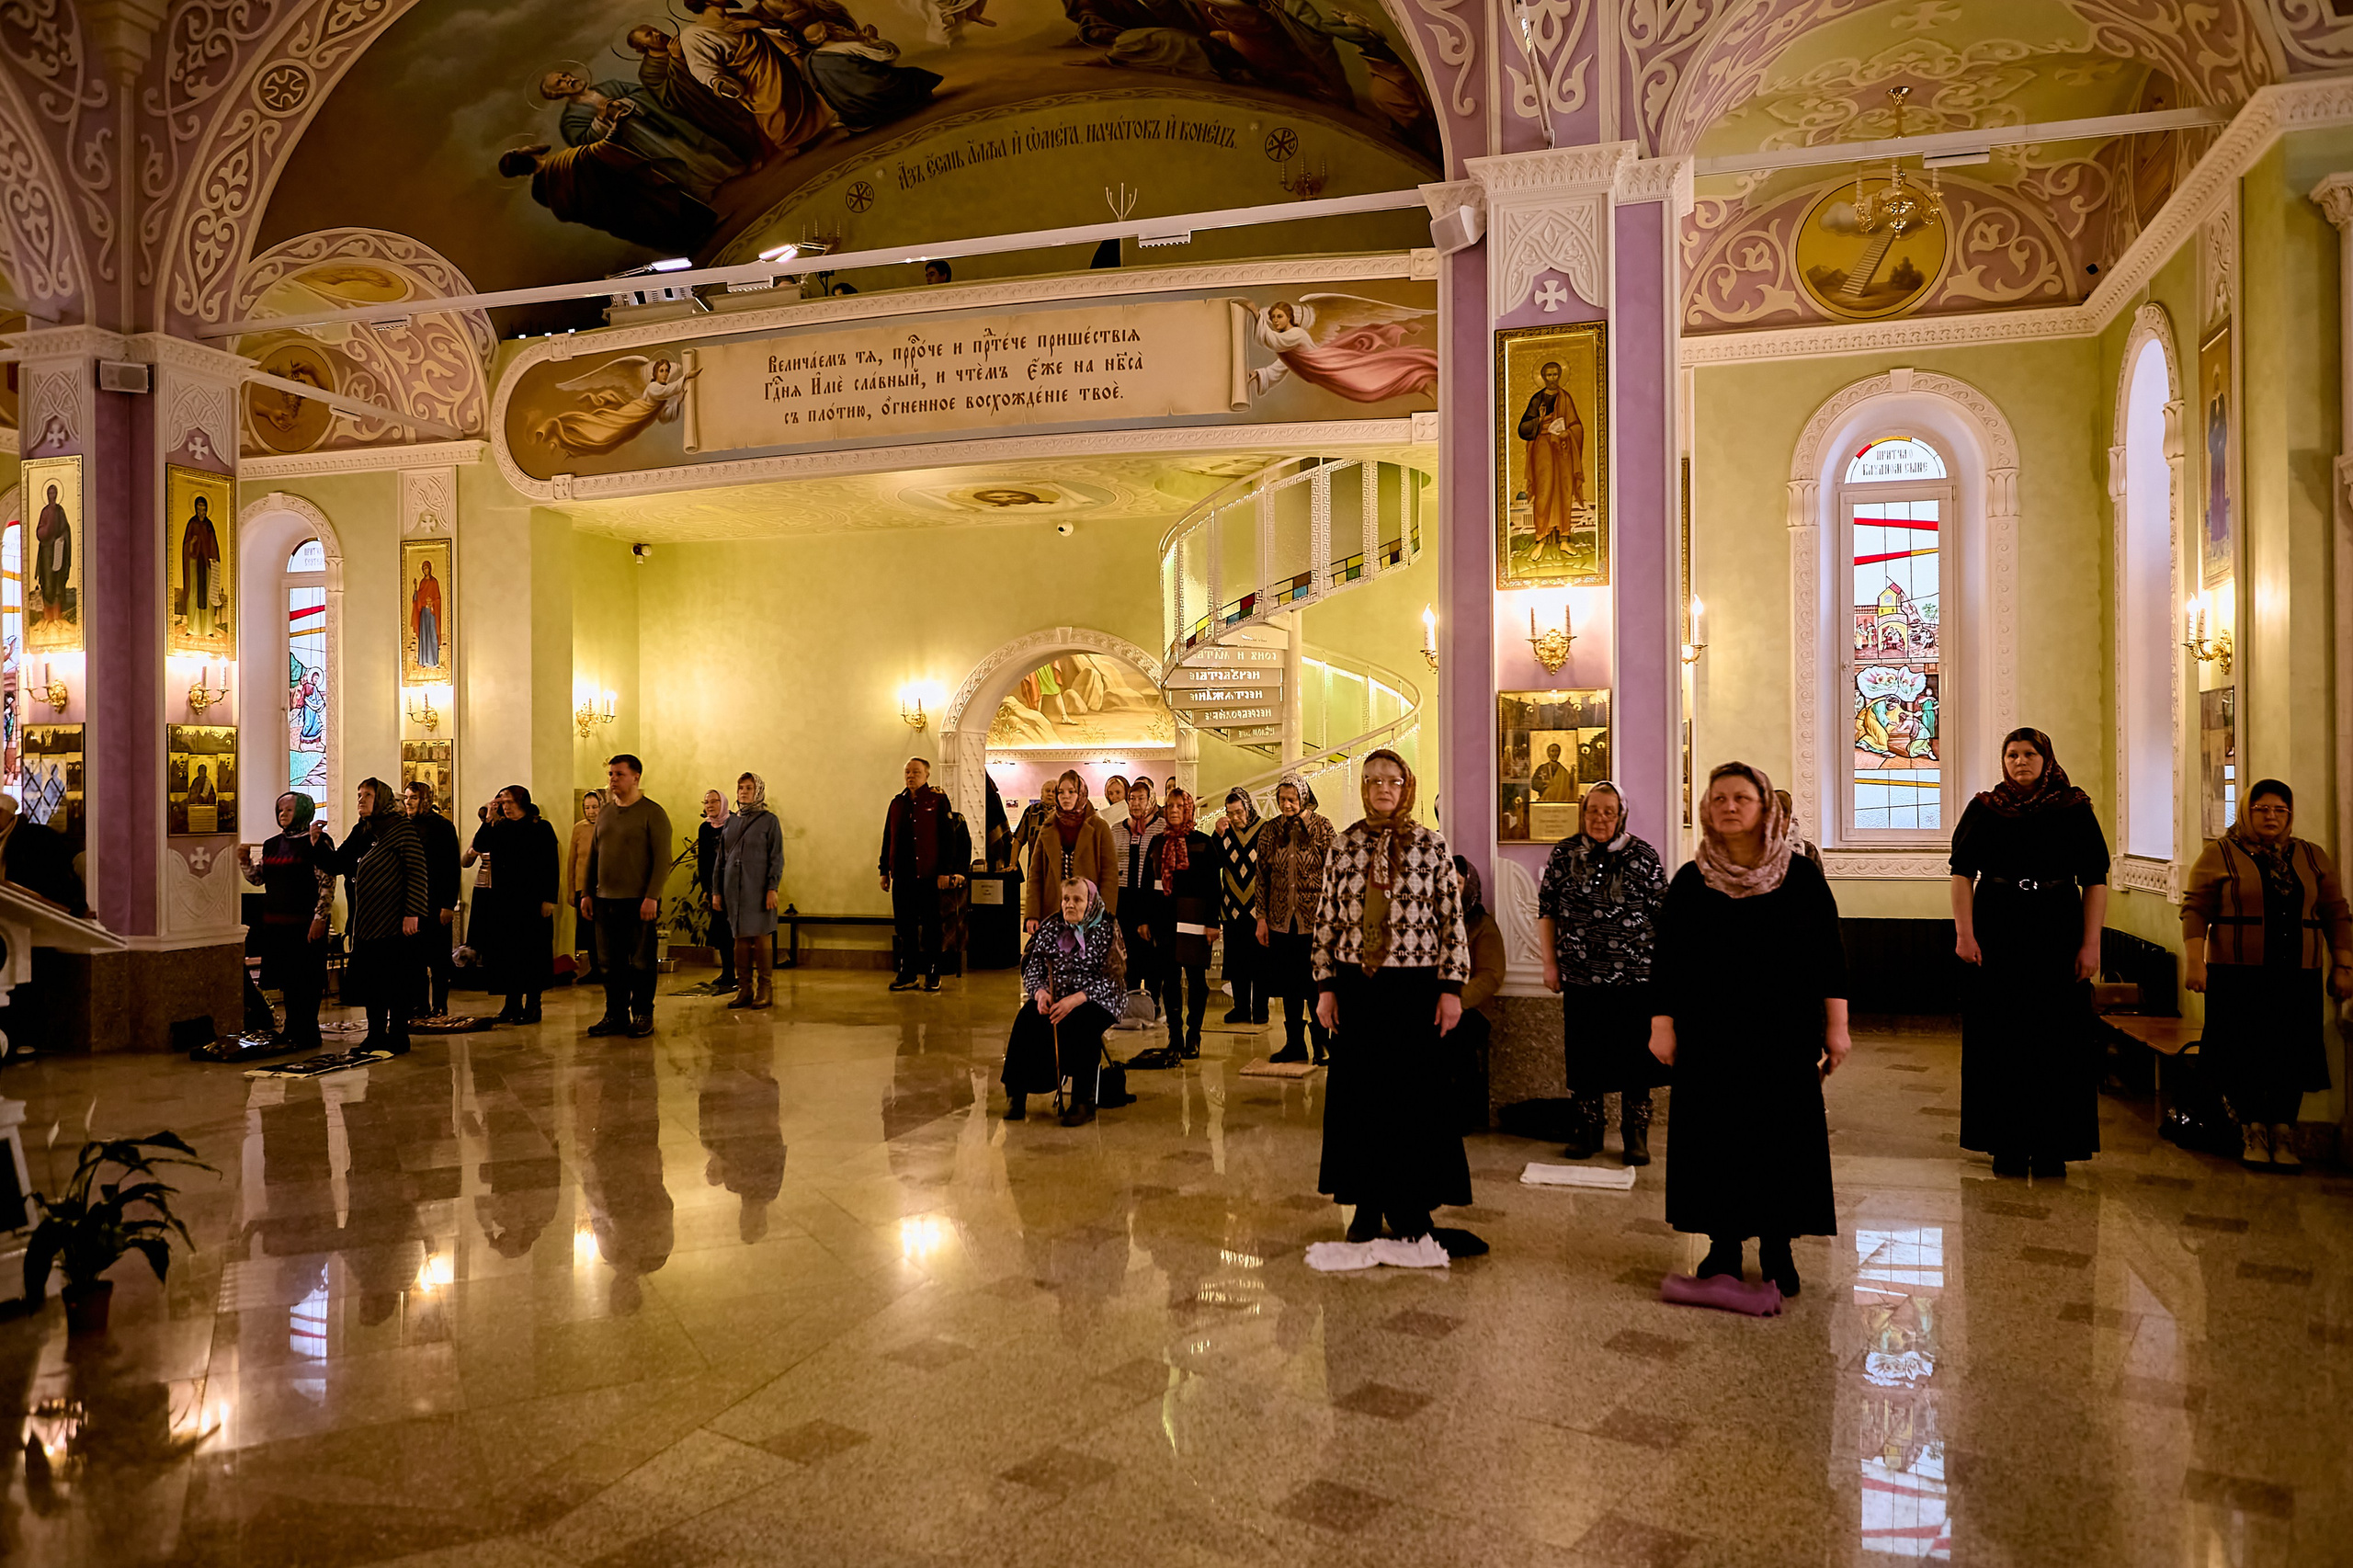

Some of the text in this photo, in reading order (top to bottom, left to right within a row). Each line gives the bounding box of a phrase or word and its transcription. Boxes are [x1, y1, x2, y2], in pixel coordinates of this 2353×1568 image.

[953, 341, 963, 357] и
[936, 371, 946, 384] и
[1074, 359, 1094, 374] на
[784, 410, 800, 425] съ
